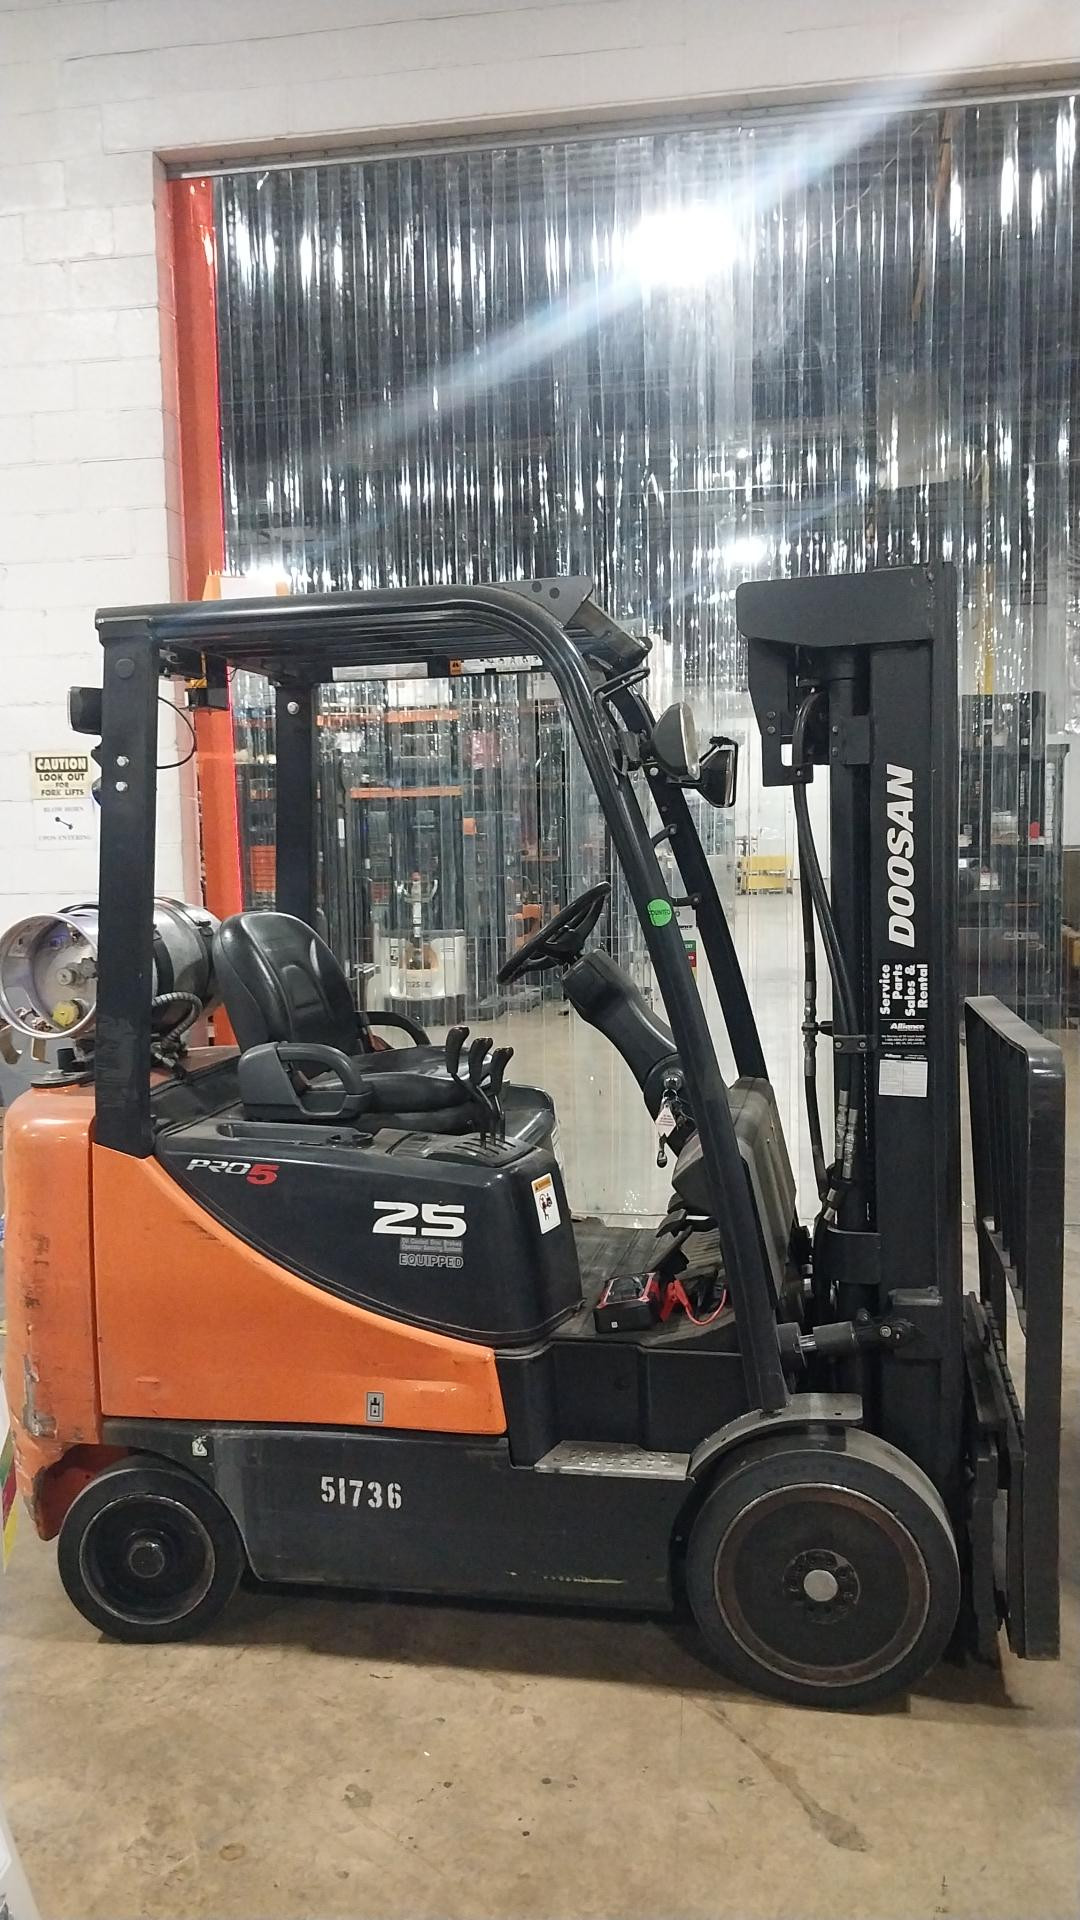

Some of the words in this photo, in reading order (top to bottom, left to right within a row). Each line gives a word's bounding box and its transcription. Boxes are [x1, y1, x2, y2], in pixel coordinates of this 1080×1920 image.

[36, 757, 87, 770] CAUTION
[39, 773, 63, 781] LOOK
[67, 773, 85, 781] OUT
[886, 763, 915, 948] DOOSAN
[892, 964, 903, 1000] Parts
[904, 964, 916, 976] &
[917, 963, 928, 1009] Rental
[879, 964, 890, 1015] Service
[904, 980, 916, 1017] Sales
[890, 1022, 926, 1031] Alliance
[372, 1200, 467, 1238] 25
[399, 1252, 464, 1269] EQUIPPED
[321, 1476, 402, 1509] 51736
